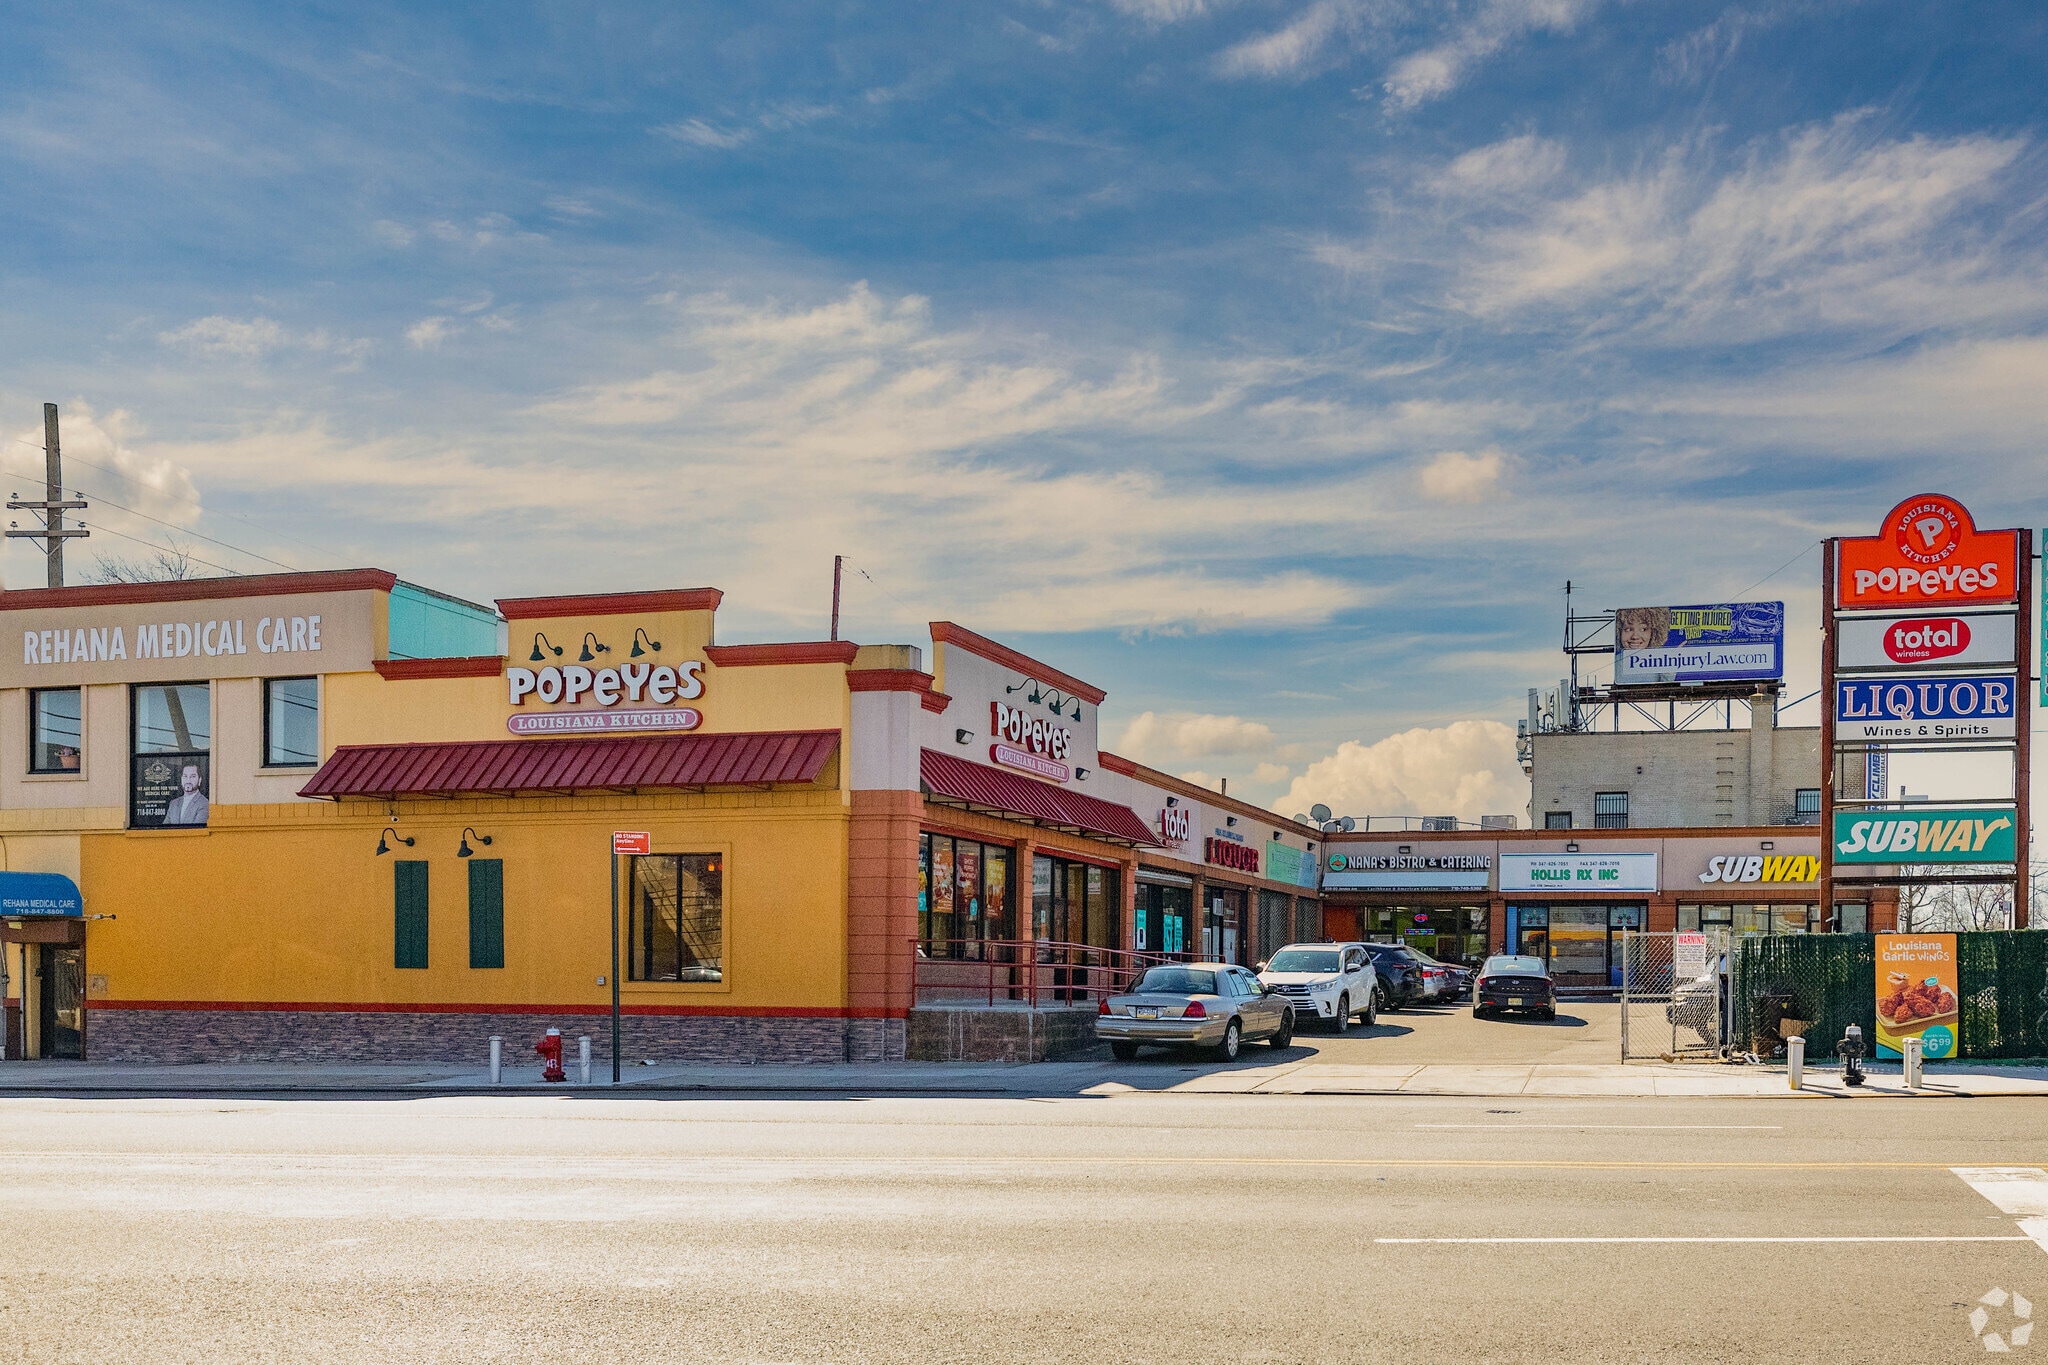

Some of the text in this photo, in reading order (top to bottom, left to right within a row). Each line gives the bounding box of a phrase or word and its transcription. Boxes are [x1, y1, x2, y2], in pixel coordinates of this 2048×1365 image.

[1898, 504, 1959, 532] LOUISIANA
[1915, 517, 1944, 547] P
[1900, 541, 1957, 563] KITCHEN
[1670, 611, 1732, 626] GETTING INJURED
[24, 615, 321, 664] REHANA MEDICAL CARE
[1894, 622, 1959, 648] total
[1629, 651, 1767, 670] PainInjuryLaw.com
[1896, 650, 1930, 658] wireless
[1843, 682, 2009, 720] LIQUOR
[518, 713, 687, 730] LOUISIANA KITCHEN
[1864, 724, 1989, 738] Wines & Spirits
[1000, 749, 1066, 778] LOUISIANA KITCHEN
[1163, 809, 1190, 841] total
[1837, 816, 2012, 855] SUBWAY
[1206, 837, 1259, 872] LIQUOR
[1348, 855, 1491, 868] NANA'S BISTRO & CATERING
[1531, 869, 1619, 881] HOLLIS RX INC
[1699, 855, 1821, 884] SUBWAY
[2, 899, 76, 908] REHANA MEDICAL CARE
[1678, 935, 1705, 945] WARNING
[1889, 941, 1942, 951] Louisiana
[1882, 951, 1915, 961] Garlic
